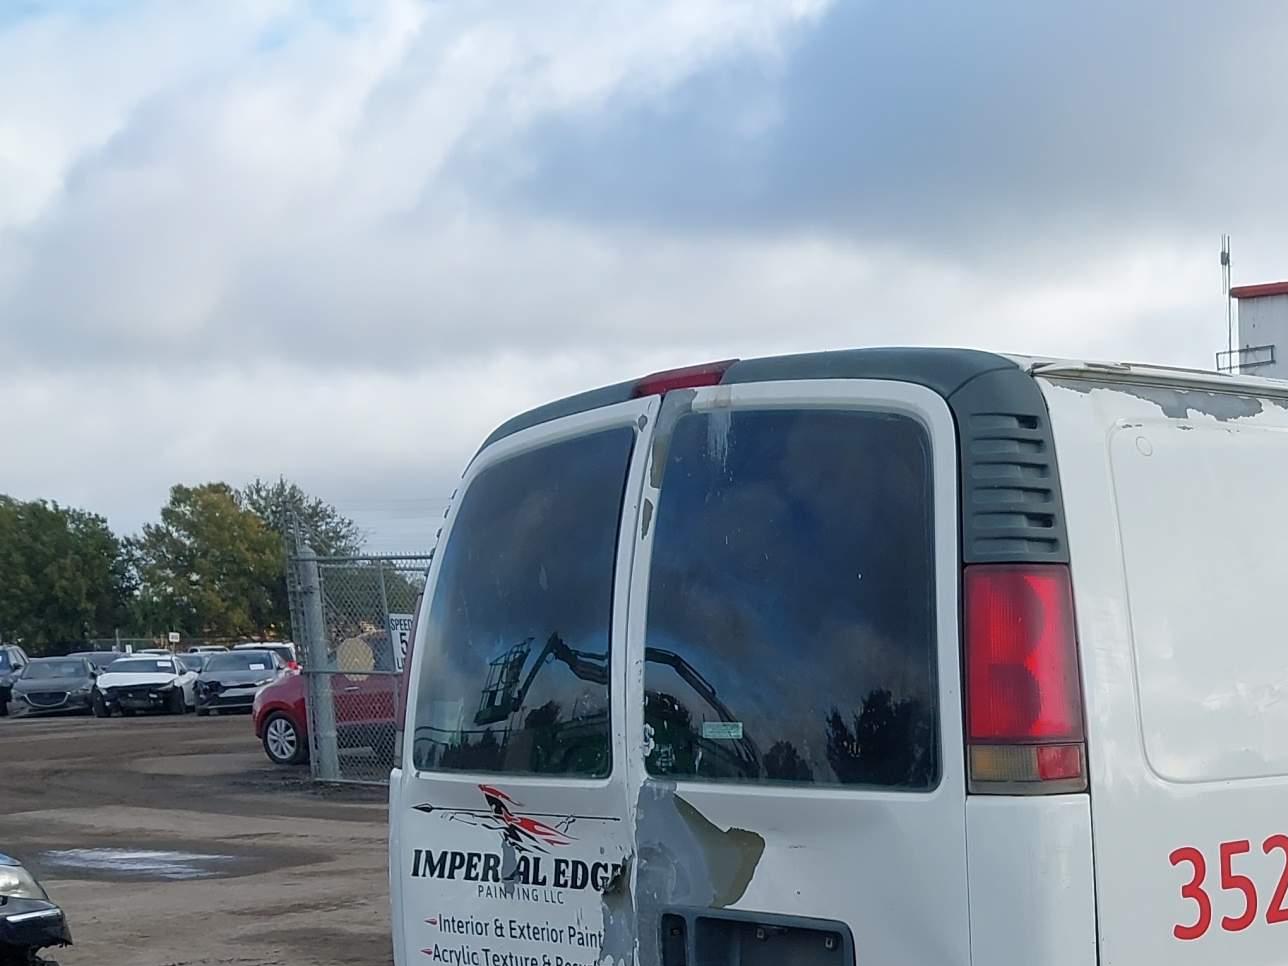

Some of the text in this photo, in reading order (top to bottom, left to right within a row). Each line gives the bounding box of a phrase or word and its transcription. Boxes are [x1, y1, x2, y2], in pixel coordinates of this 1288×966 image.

[411, 849, 547, 886] IMPERAL
[544, 889, 564, 905] LLC
[439, 913, 490, 938] Interior
[494, 918, 505, 937] &
[510, 920, 564, 945] Exterior
